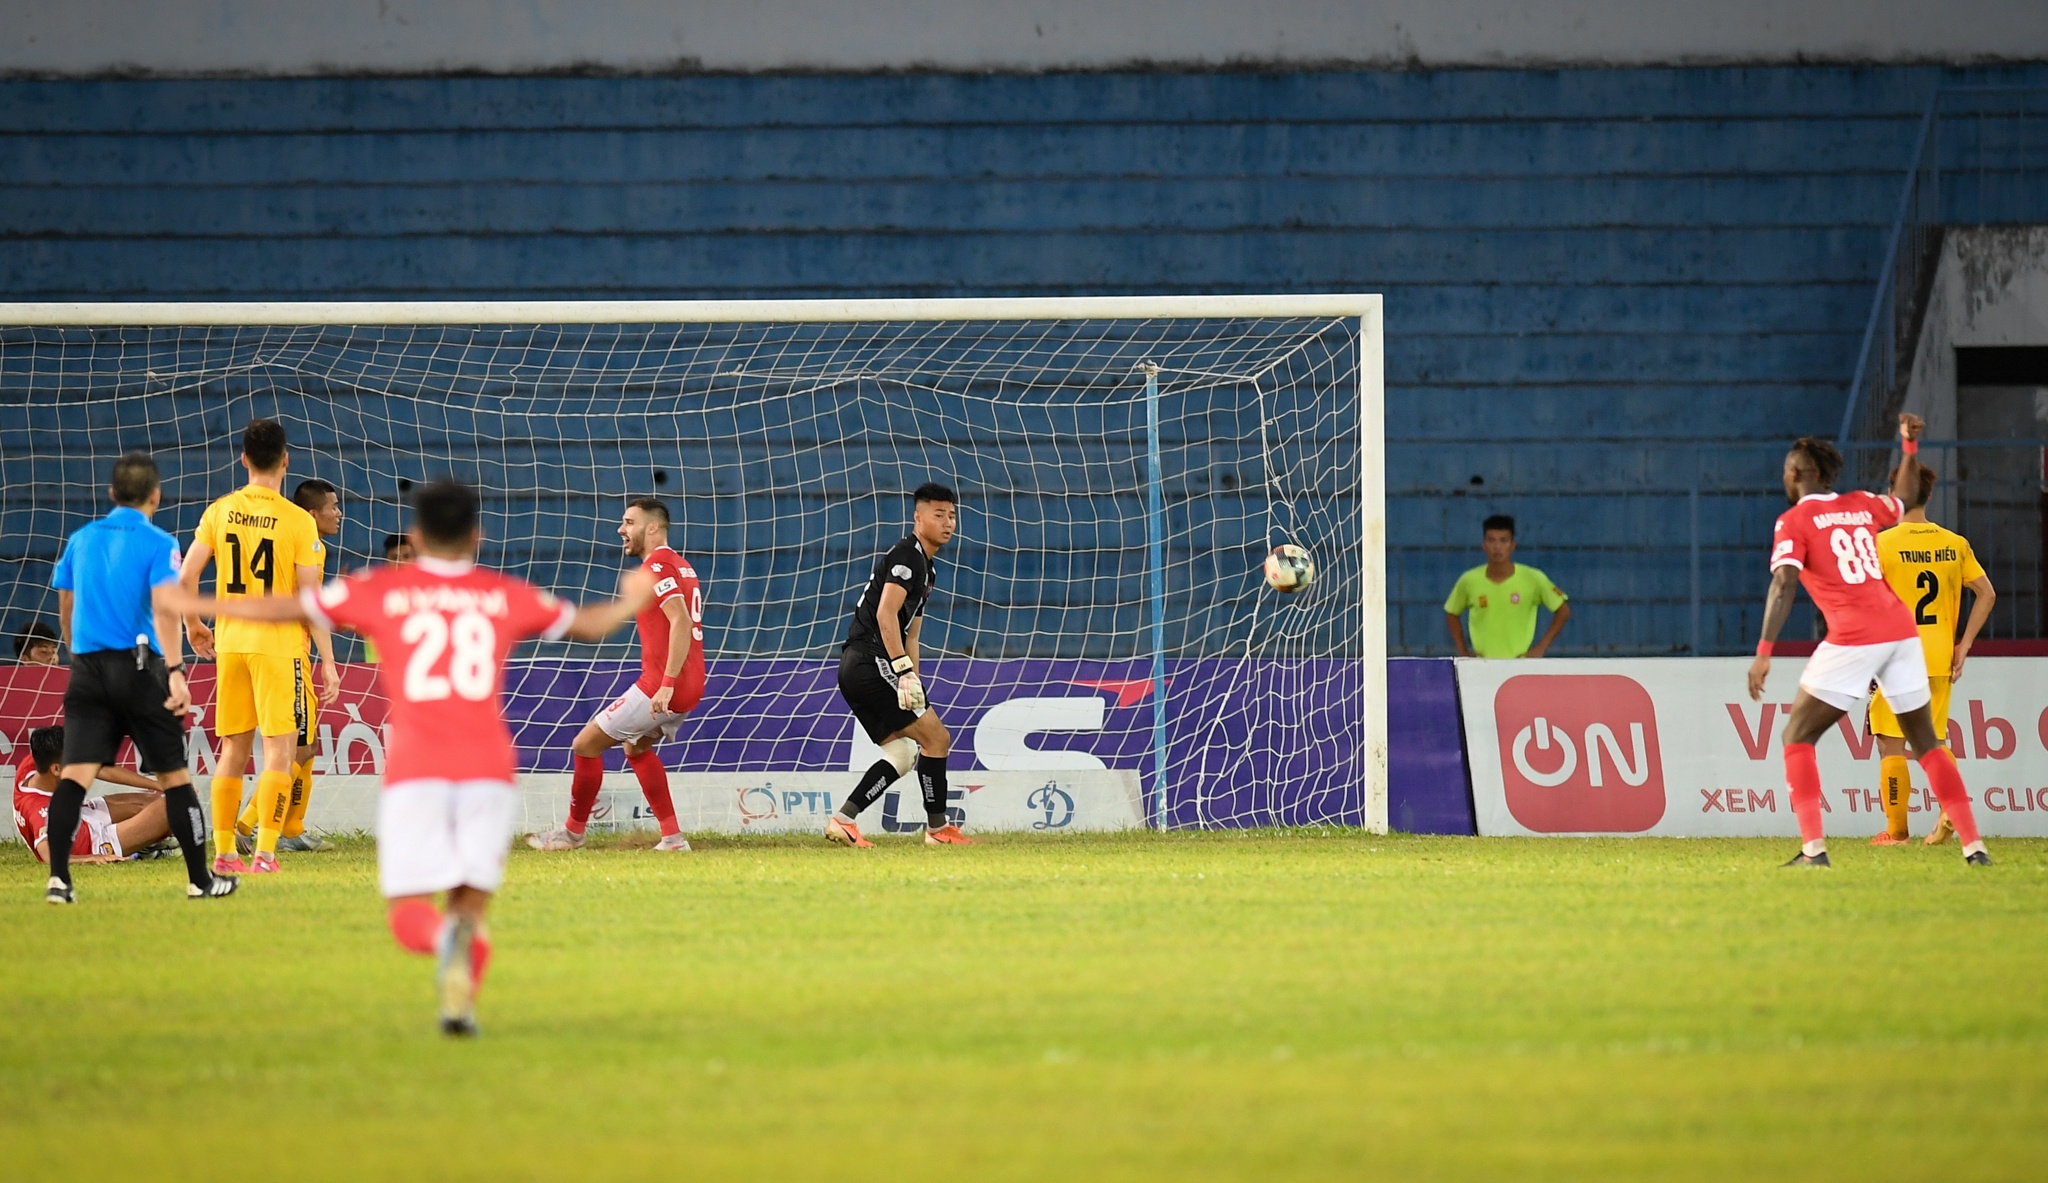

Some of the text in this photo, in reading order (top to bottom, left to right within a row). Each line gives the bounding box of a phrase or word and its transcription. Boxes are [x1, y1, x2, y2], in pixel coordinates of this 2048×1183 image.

[228, 510, 278, 530] SCHMIDT
[226, 533, 274, 597] 14
[1830, 527, 1883, 584] 80
[1899, 551, 1931, 563] TRUNG
[1915, 570, 1939, 625] 2
[401, 610, 496, 702] 28
[1512, 716, 1648, 787] ON
[782, 791, 832, 815] PTI
[1700, 788, 1776, 813] XEM
